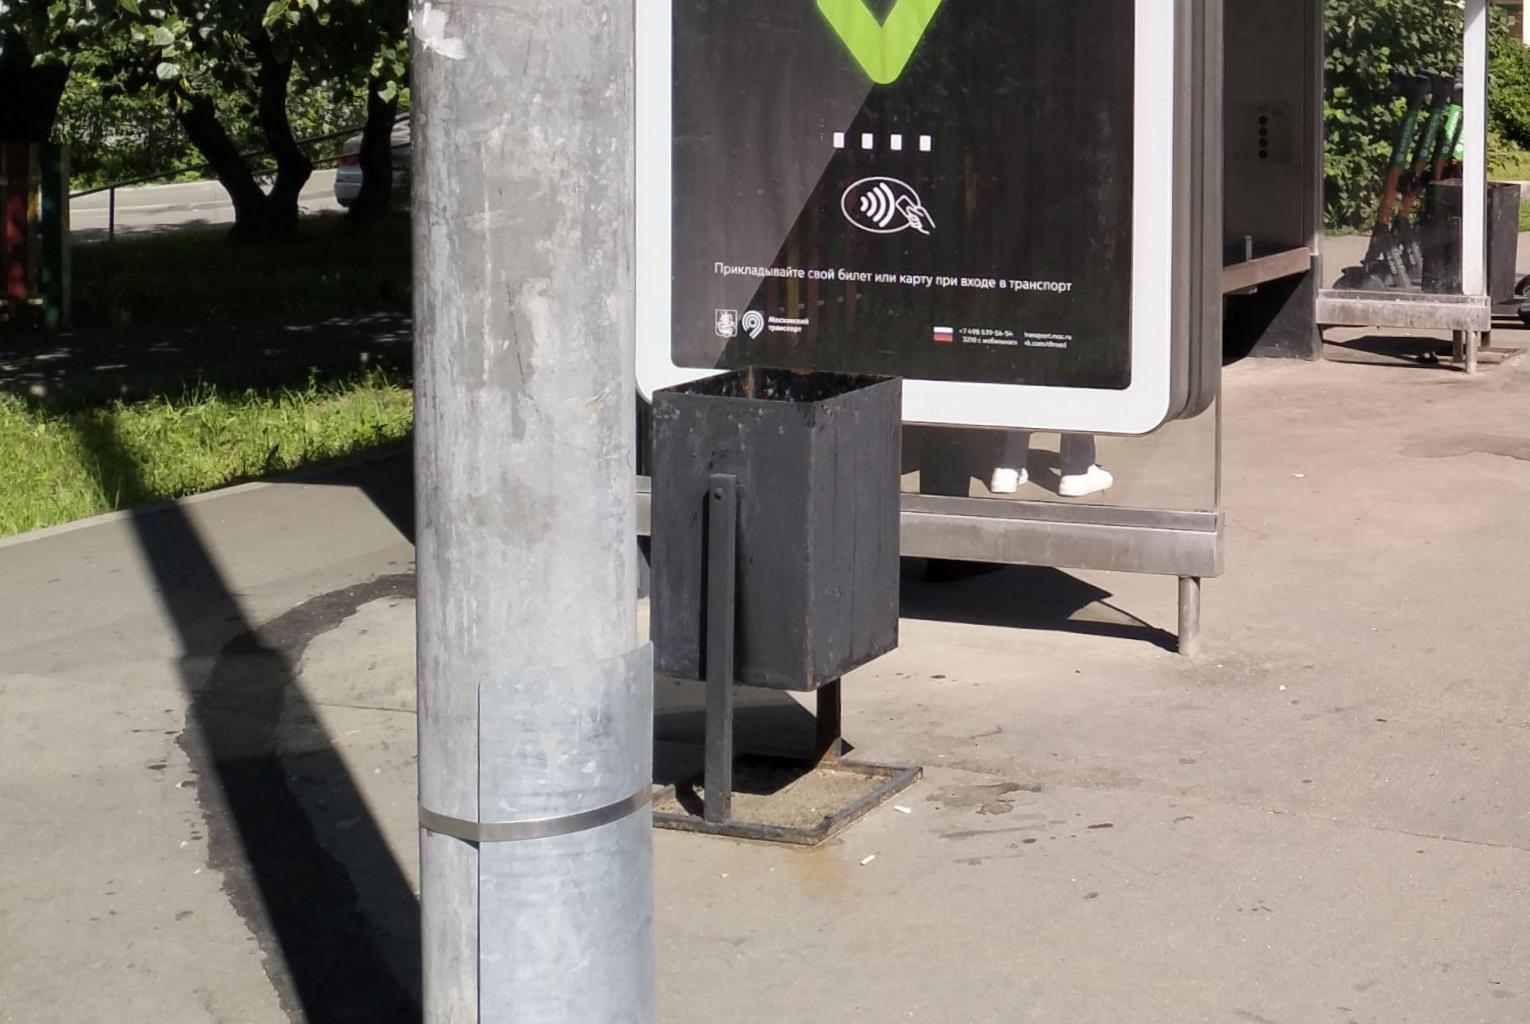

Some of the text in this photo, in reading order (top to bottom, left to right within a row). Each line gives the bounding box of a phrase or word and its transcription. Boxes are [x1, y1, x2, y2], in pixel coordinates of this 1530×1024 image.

[714, 261, 1073, 294] Прикладывайте свой билет или карту при входе в транспорт
